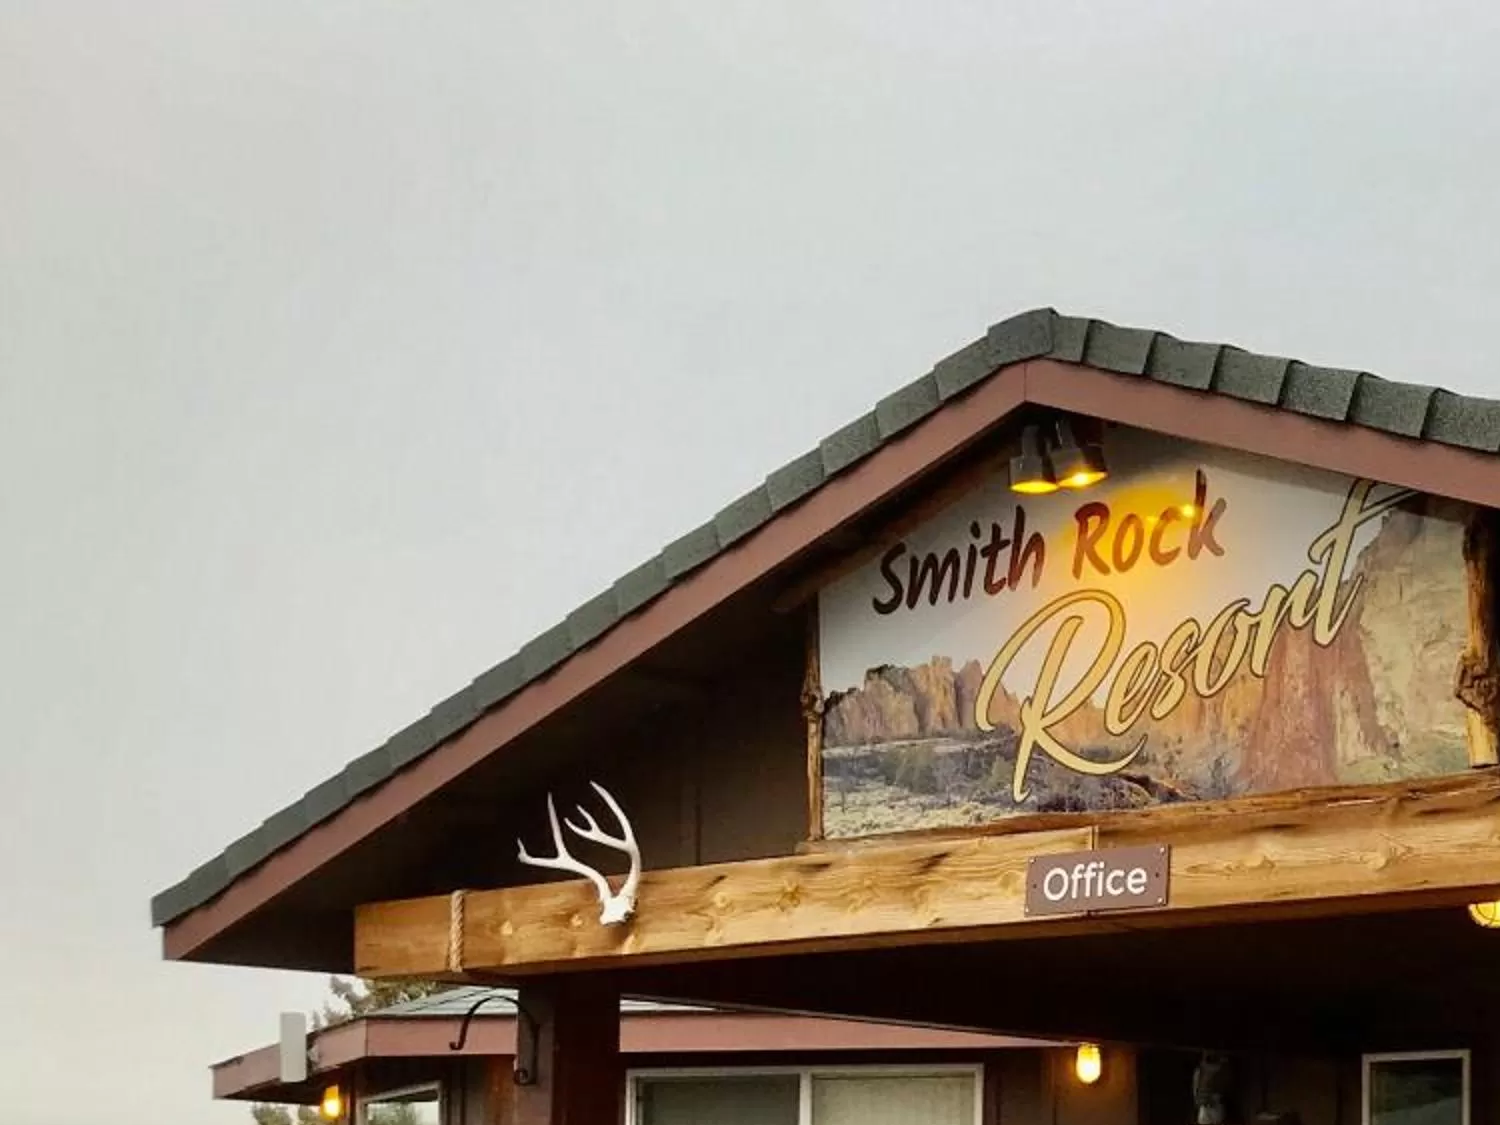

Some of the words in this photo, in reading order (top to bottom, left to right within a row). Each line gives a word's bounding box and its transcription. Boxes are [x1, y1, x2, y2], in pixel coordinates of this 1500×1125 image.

[872, 504, 1046, 615] Smith
[1072, 469, 1226, 580] Rock
[974, 476, 1424, 803] Resort
[1043, 861, 1147, 901] Office
